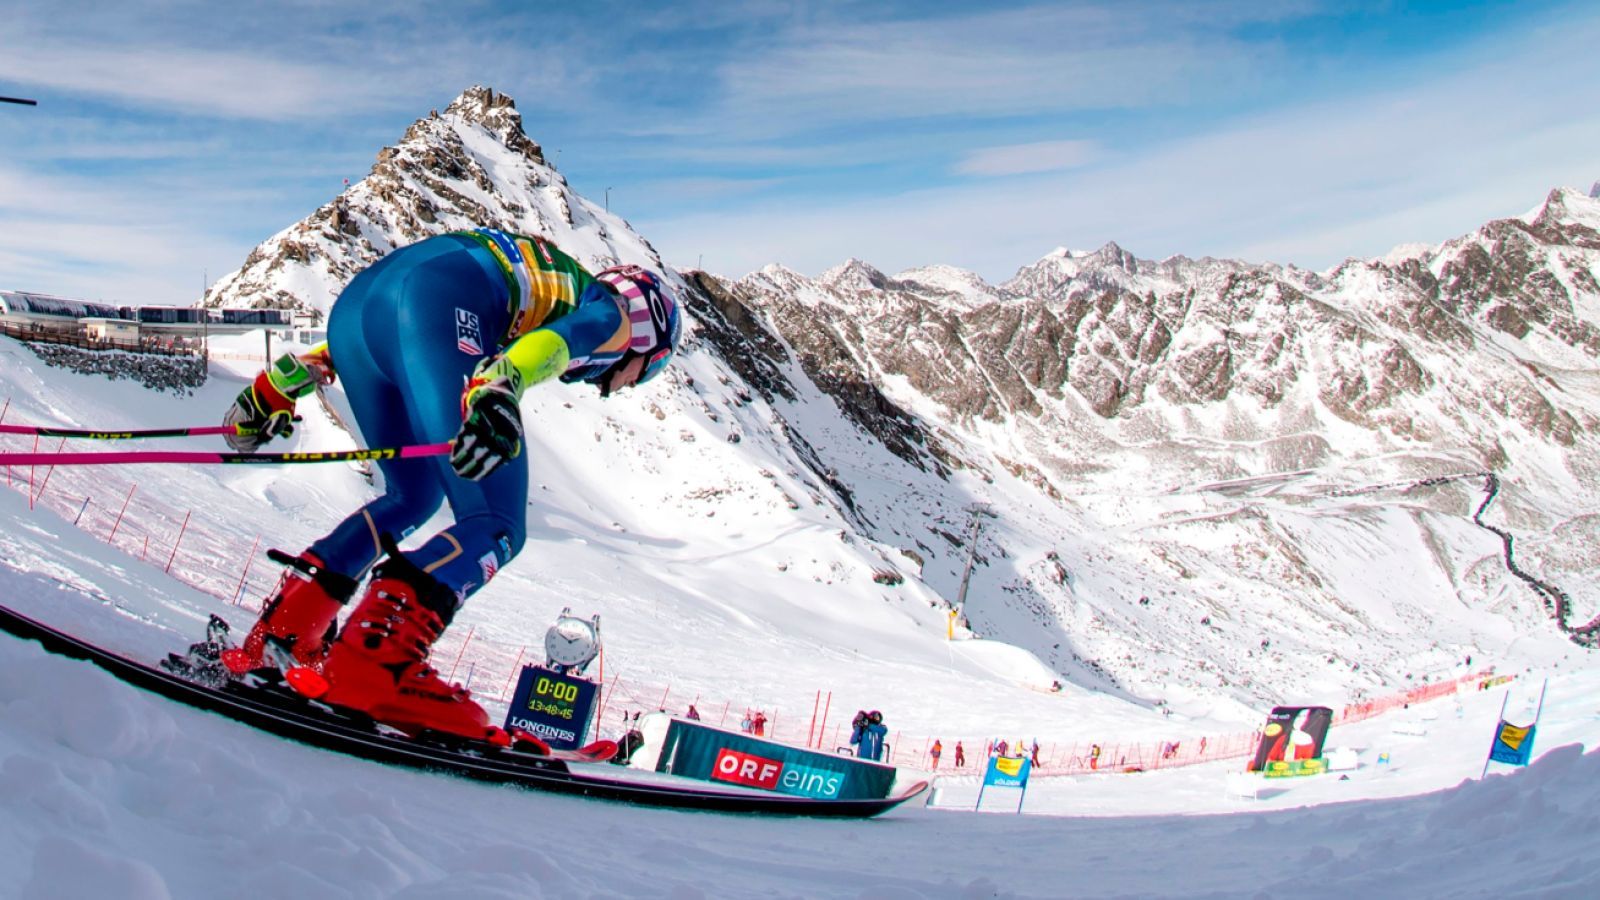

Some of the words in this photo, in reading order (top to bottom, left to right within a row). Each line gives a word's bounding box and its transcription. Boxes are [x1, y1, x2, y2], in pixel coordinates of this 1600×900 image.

[536, 678, 578, 702] 0:00
[510, 716, 576, 742] LONGINES
[719, 755, 778, 781] ORF
[783, 769, 839, 796] eins
